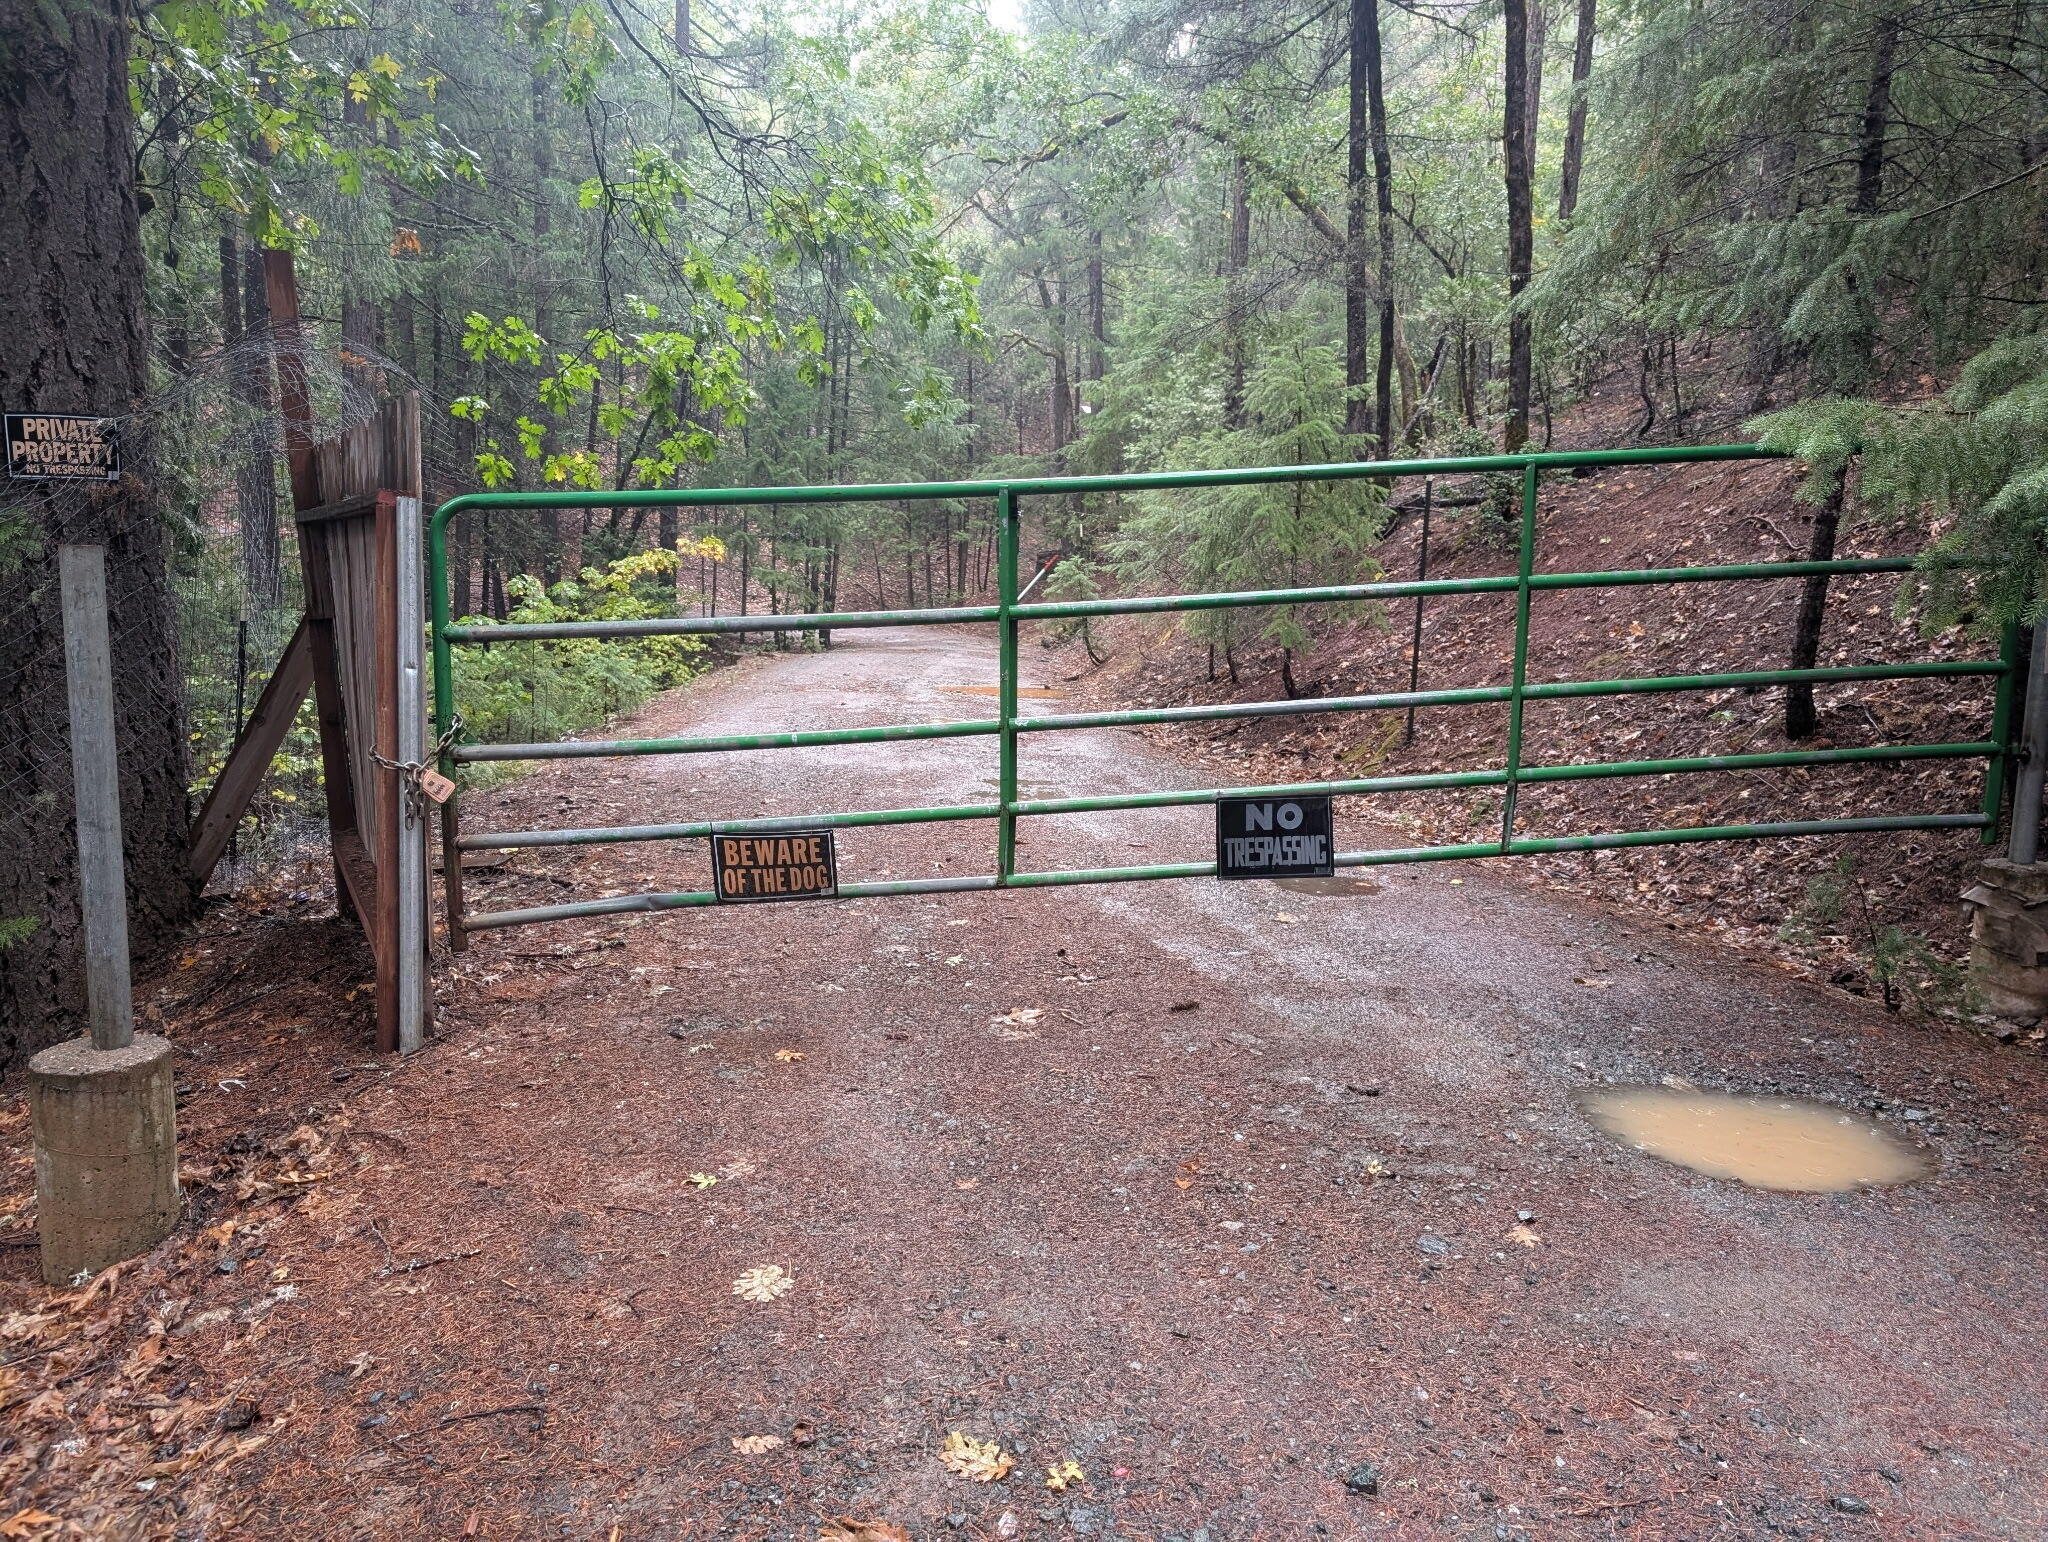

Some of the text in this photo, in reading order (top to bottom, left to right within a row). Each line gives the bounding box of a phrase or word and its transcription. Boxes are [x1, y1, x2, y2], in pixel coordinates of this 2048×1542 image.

[22, 418, 103, 442] PRIVATE
[12, 441, 113, 465] PROPERTY
[26, 464, 40, 474] NO
[1245, 802, 1304, 831] NO
[723, 837, 823, 866] BEWARE
[1223, 834, 1327, 868] TRESPASSING
[723, 865, 829, 894] OF THE DOG
